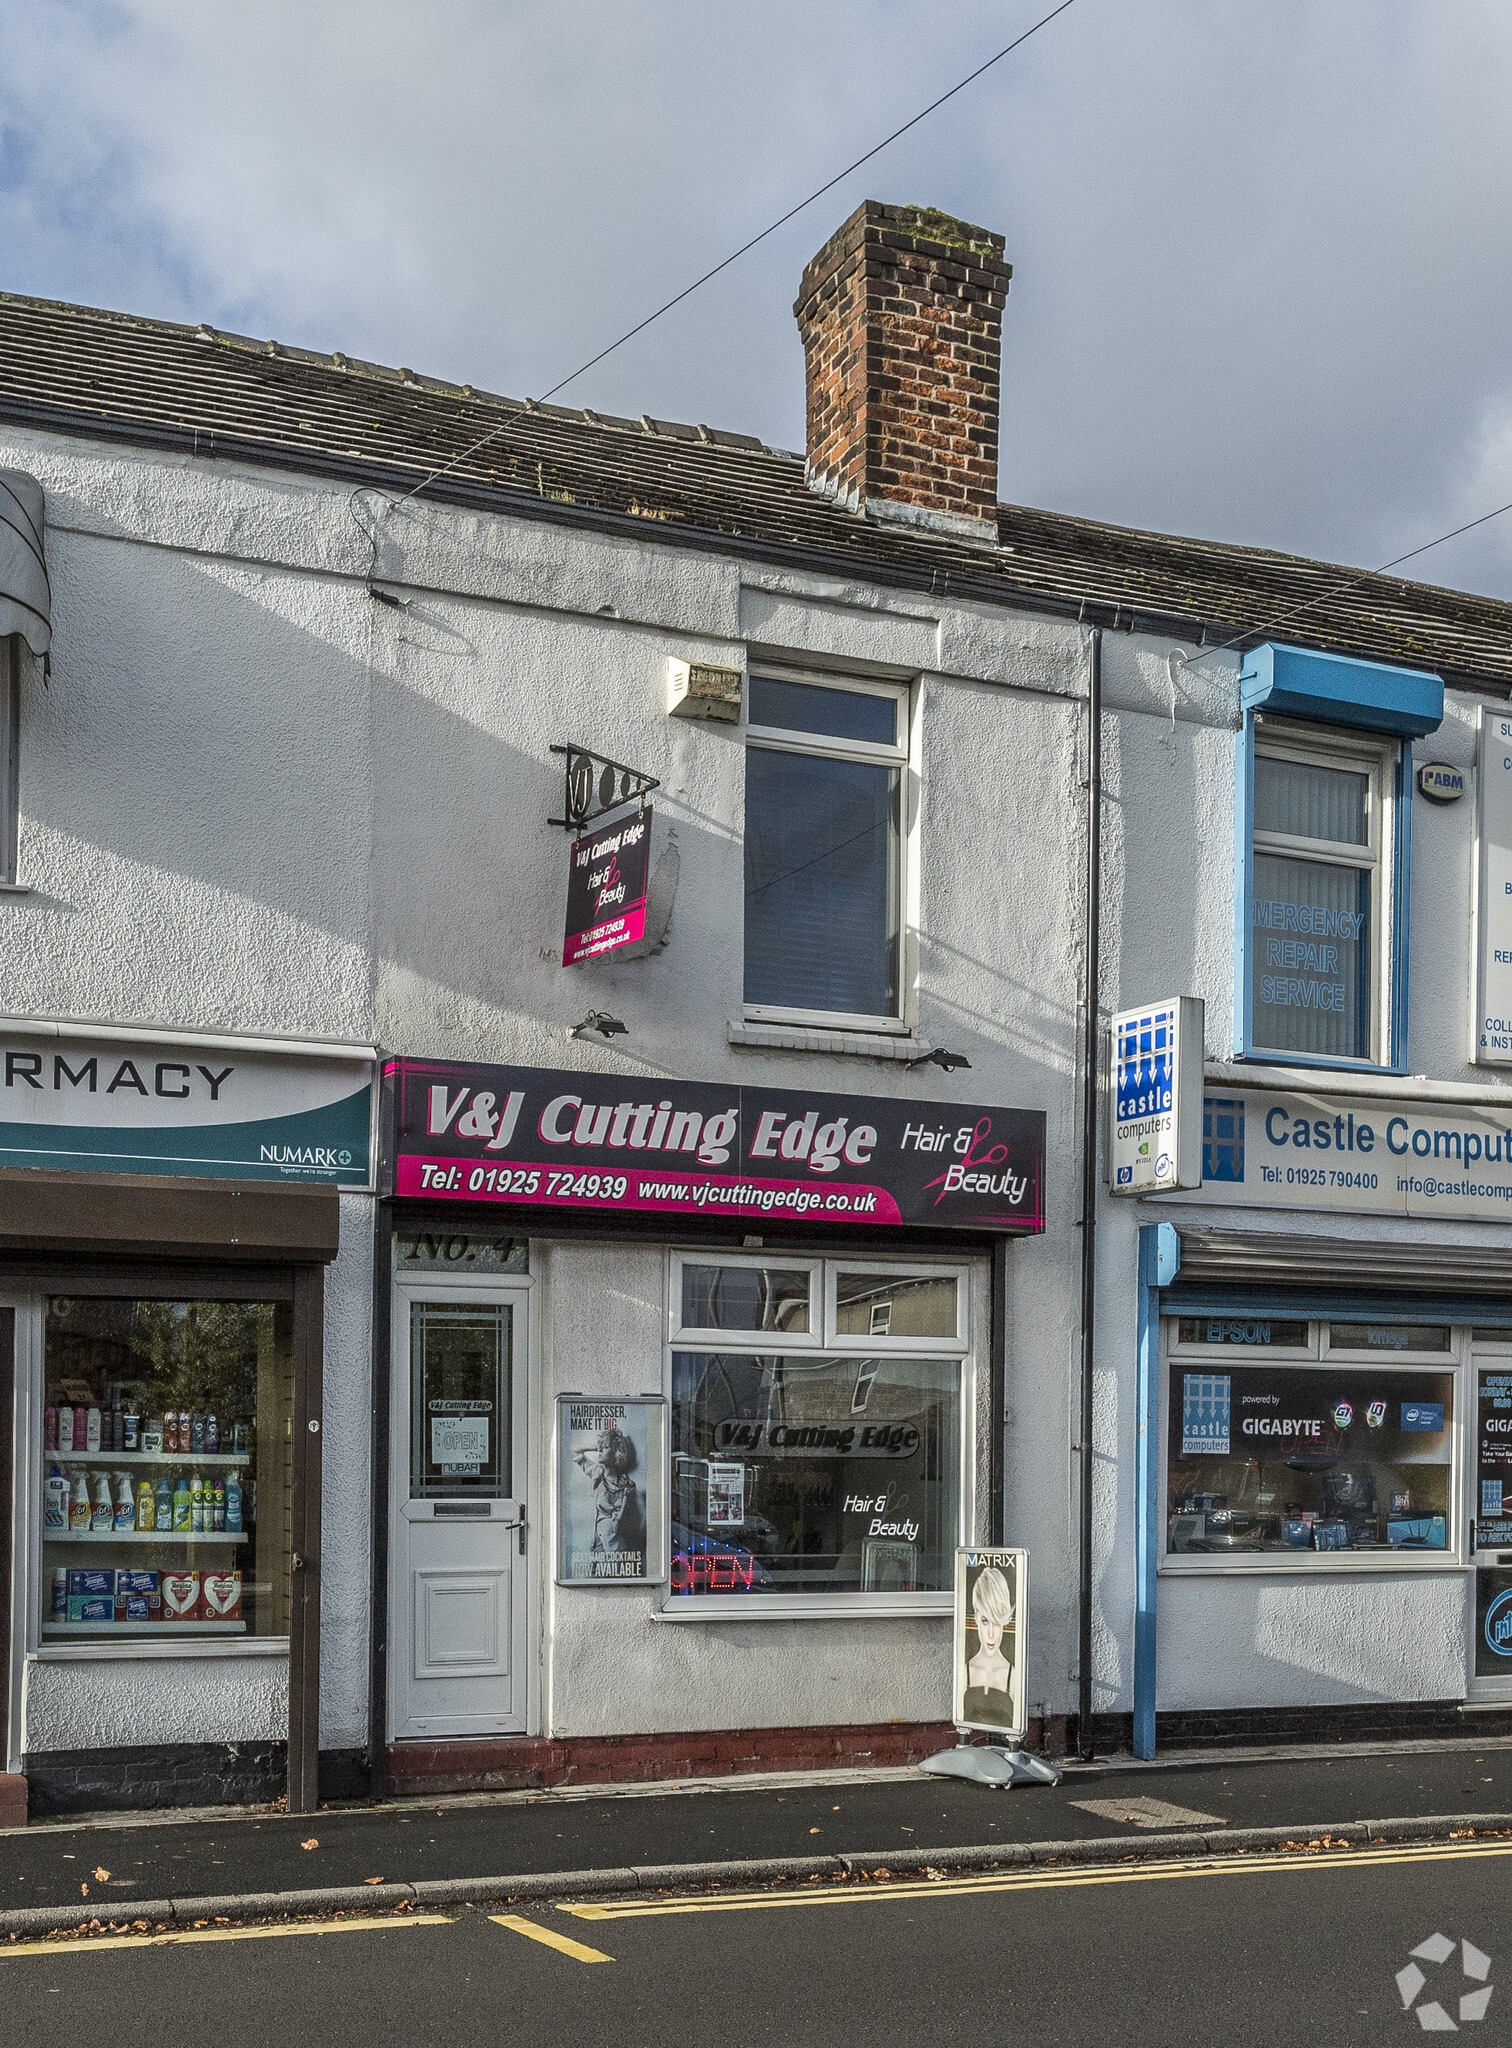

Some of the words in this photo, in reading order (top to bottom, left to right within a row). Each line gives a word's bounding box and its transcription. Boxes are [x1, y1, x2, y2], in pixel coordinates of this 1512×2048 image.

[1433, 772, 1464, 790] ABM
[576, 847, 591, 867] V&J
[591, 832, 621, 860] Cutting
[621, 824, 645, 847] Edge
[587, 869, 602, 890] Hair
[598, 881, 625, 907] Beauty
[1255, 899, 1364, 940] MERGENCY
[1266, 938, 1338, 974] REPAIR
[1261, 975, 1344, 1012] SERVICE
[1480, 1033, 1488, 1047] &
[6, 1052, 235, 1101] RMACY
[1118, 1086, 1171, 1117] castle
[427, 1085, 526, 1150] V&J
[537, 1094, 738, 1166] Cutting
[749, 1111, 878, 1174] Edge
[900, 1123, 950, 1153] Hair
[952, 1127, 973, 1154] &
[1117, 1117, 1171, 1141] computers
[1265, 1107, 1375, 1153] Castle
[1387, 1117, 1512, 1169] Comput
[260, 1145, 337, 1167] NUMARK
[420, 1165, 462, 1191] Tel:
[468, 1167, 541, 1195] 01925
[545, 1172, 628, 1200] 724939
[638, 1180, 877, 1213] www.vjcuttingedge.co.uk
[943, 1164, 1027, 1204] Beauty
[1260, 1165, 1283, 1184] Tel:
[1287, 1168, 1326, 1187] 01925
[1329, 1171, 1378, 1190] 790400
[1207, 1320, 1271, 1344] EPSON
[445, 1402, 471, 1410] Cutting
[473, 1402, 491, 1410] Edge
[1242, 1394, 1271, 1405] powered
[1272, 1395, 1280, 1406] by
[570, 1405, 627, 1419] HAIRDRESSER,
[570, 1418, 593, 1431] MAKE
[595, 1418, 602, 1431] IT
[1184, 1421, 1229, 1436] castle
[1242, 1418, 1321, 1436] GIGABYTE
[444, 1431, 479, 1450] OPEN
[721, 1423, 763, 1450] V&J
[768, 1425, 856, 1454] Cutting
[859, 1426, 918, 1453] Edge
[1184, 1440, 1229, 1452] computers
[843, 1495, 873, 1512] Hair
[874, 1495, 887, 1512] &
[868, 1517, 920, 1541] Beauty
[606, 1551, 642, 1562] COCKTAILS
[966, 1553, 1016, 1567] MATRIX
[85, 1574, 105, 1587] Tempo
[131, 1574, 151, 1587] Tempo
[594, 1562, 642, 1577] AVAILABLE
[671, 1556, 754, 1588] OPEN
